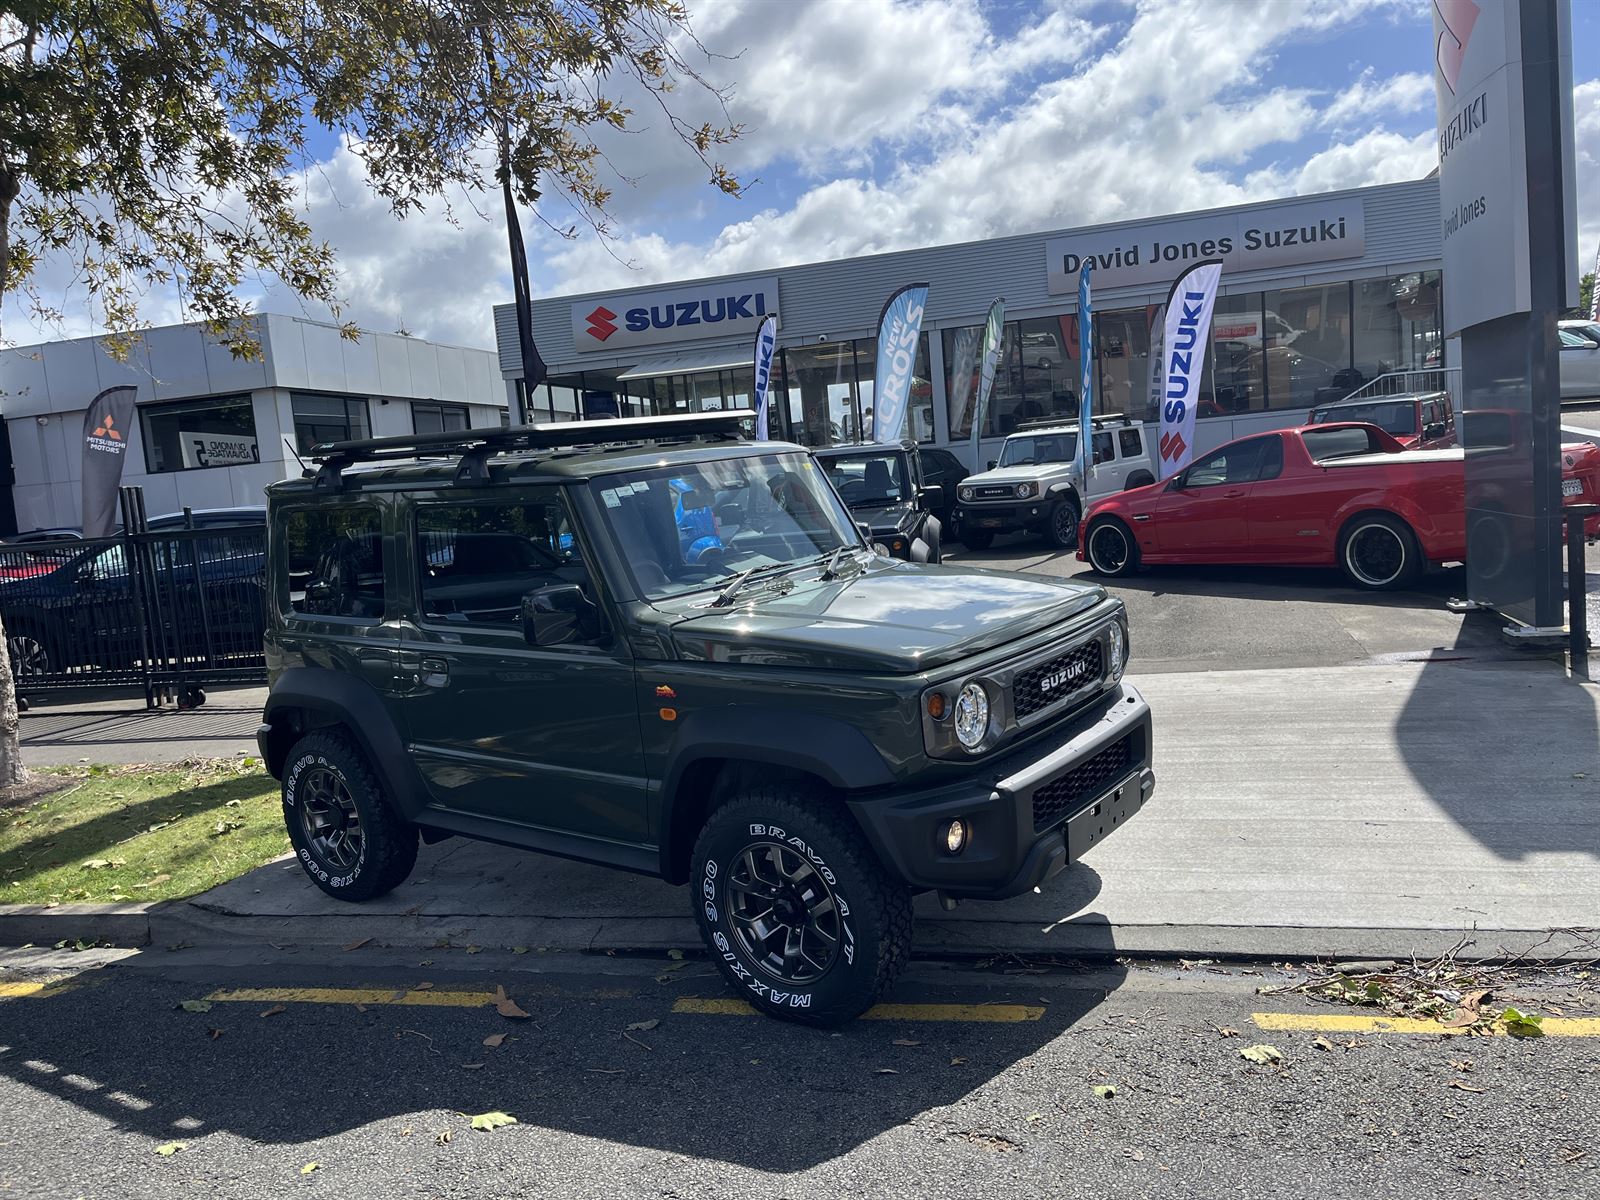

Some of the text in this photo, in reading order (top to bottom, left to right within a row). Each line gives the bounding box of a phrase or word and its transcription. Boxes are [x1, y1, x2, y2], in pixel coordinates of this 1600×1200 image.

[1440, 92, 1488, 163] SUZUKI
[1460, 195, 1486, 229] Jones
[1063, 216, 1347, 275] David Jones Suzuki
[625, 292, 766, 332] SUZUKI
[885, 315, 903, 357] NEW
[1164, 291, 1205, 424] SUZUKI
[86, 436, 127, 449] MITSUBISHI
[90, 444, 120, 454] MOTORS
[1041, 660, 1086, 692] SUZUKI
[286, 754, 315, 806] BRAVO
[749, 823, 855, 966] BRAVO A/T
[703, 859, 813, 1008] MAXXIS 980
